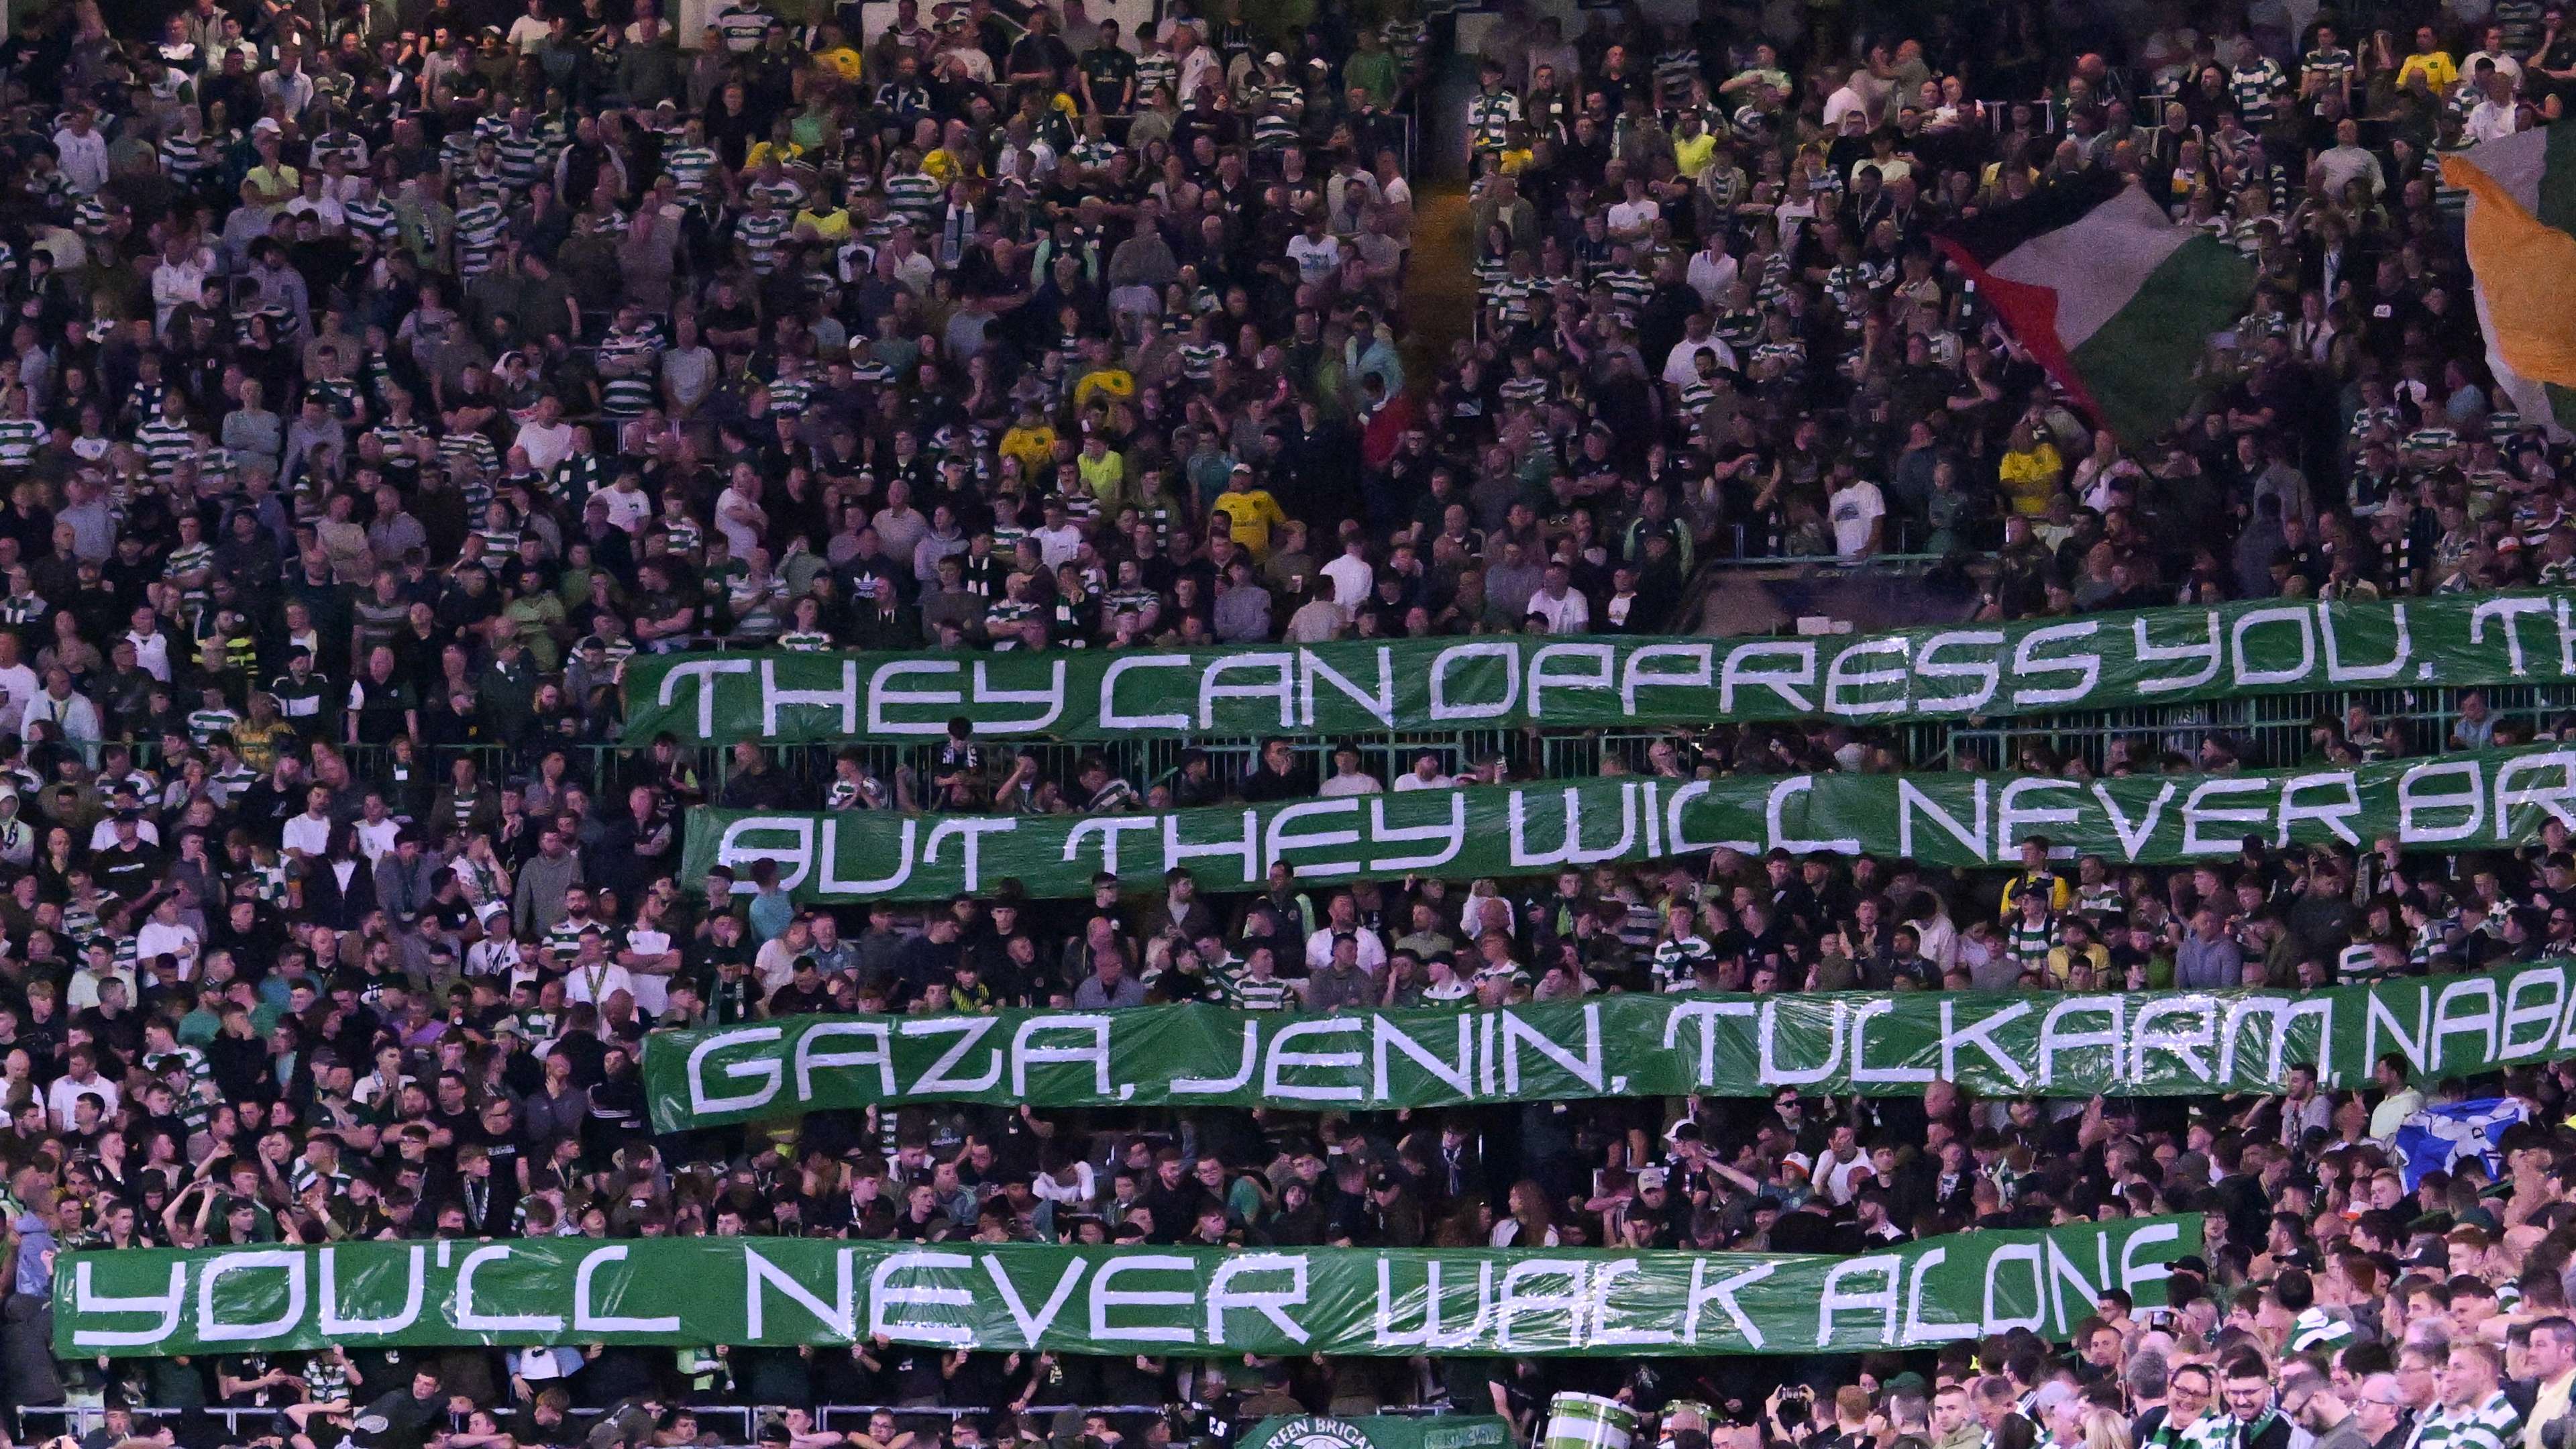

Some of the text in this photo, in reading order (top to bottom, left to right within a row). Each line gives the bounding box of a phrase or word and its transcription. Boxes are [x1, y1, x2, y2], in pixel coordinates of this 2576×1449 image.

[658, 659, 1065, 737] THEY
[1100, 647, 1393, 729] CAN
[1430, 621, 2100, 721] OPPRESS
[2470, 596, 2576, 678] T
[718, 816, 1016, 893] BUT
[1063, 792, 1464, 881] THEY
[1509, 775, 1860, 867] WILL
[1898, 776, 2361, 863] NEVER
[688, 1016, 1135, 1115] GAZA,
[1169, 1002, 1627, 1100] JENIN,
[73, 1223, 2179, 1350] YOU'LL NEVER WALK ALONE
[1263, 1417, 1309, 1449] REEN
